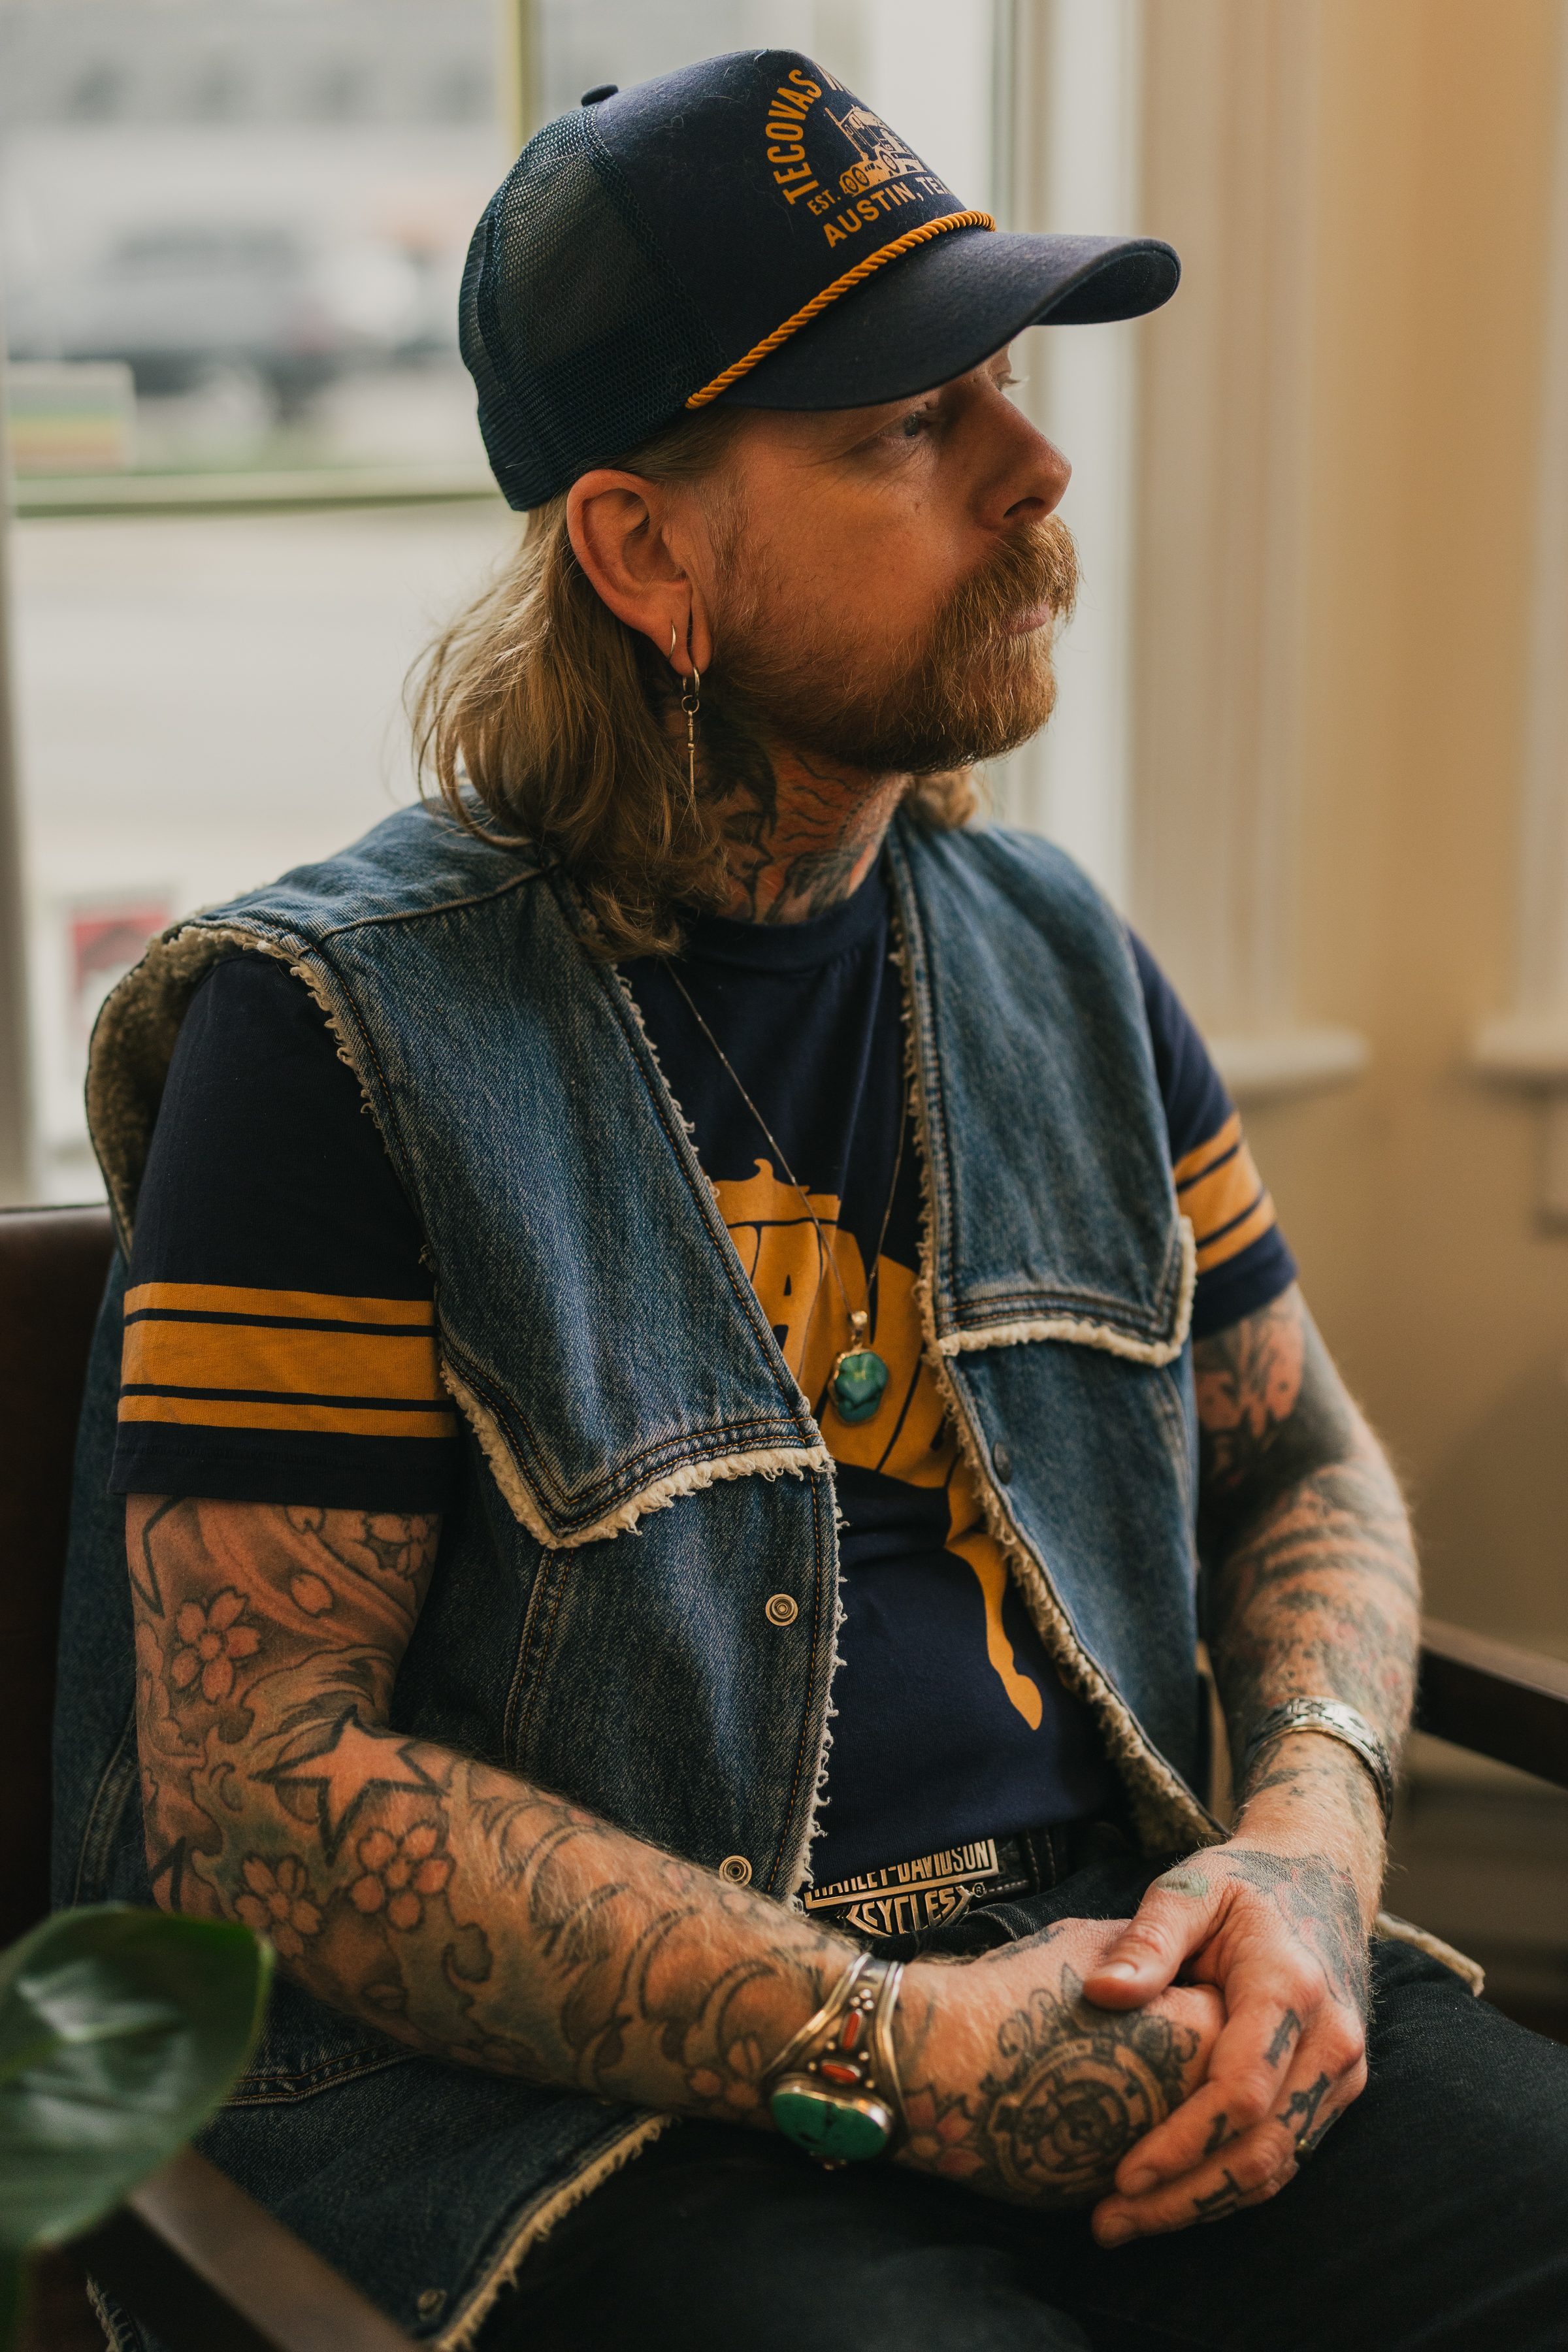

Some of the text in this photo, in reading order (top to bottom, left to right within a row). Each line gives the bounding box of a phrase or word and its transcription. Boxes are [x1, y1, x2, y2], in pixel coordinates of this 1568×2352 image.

[765, 69, 822, 205] TECOVAS
[807, 189, 841, 216] EST.
[823, 182, 924, 249] AUSTIN,
[862, 1887, 956, 1935] CYCLES
